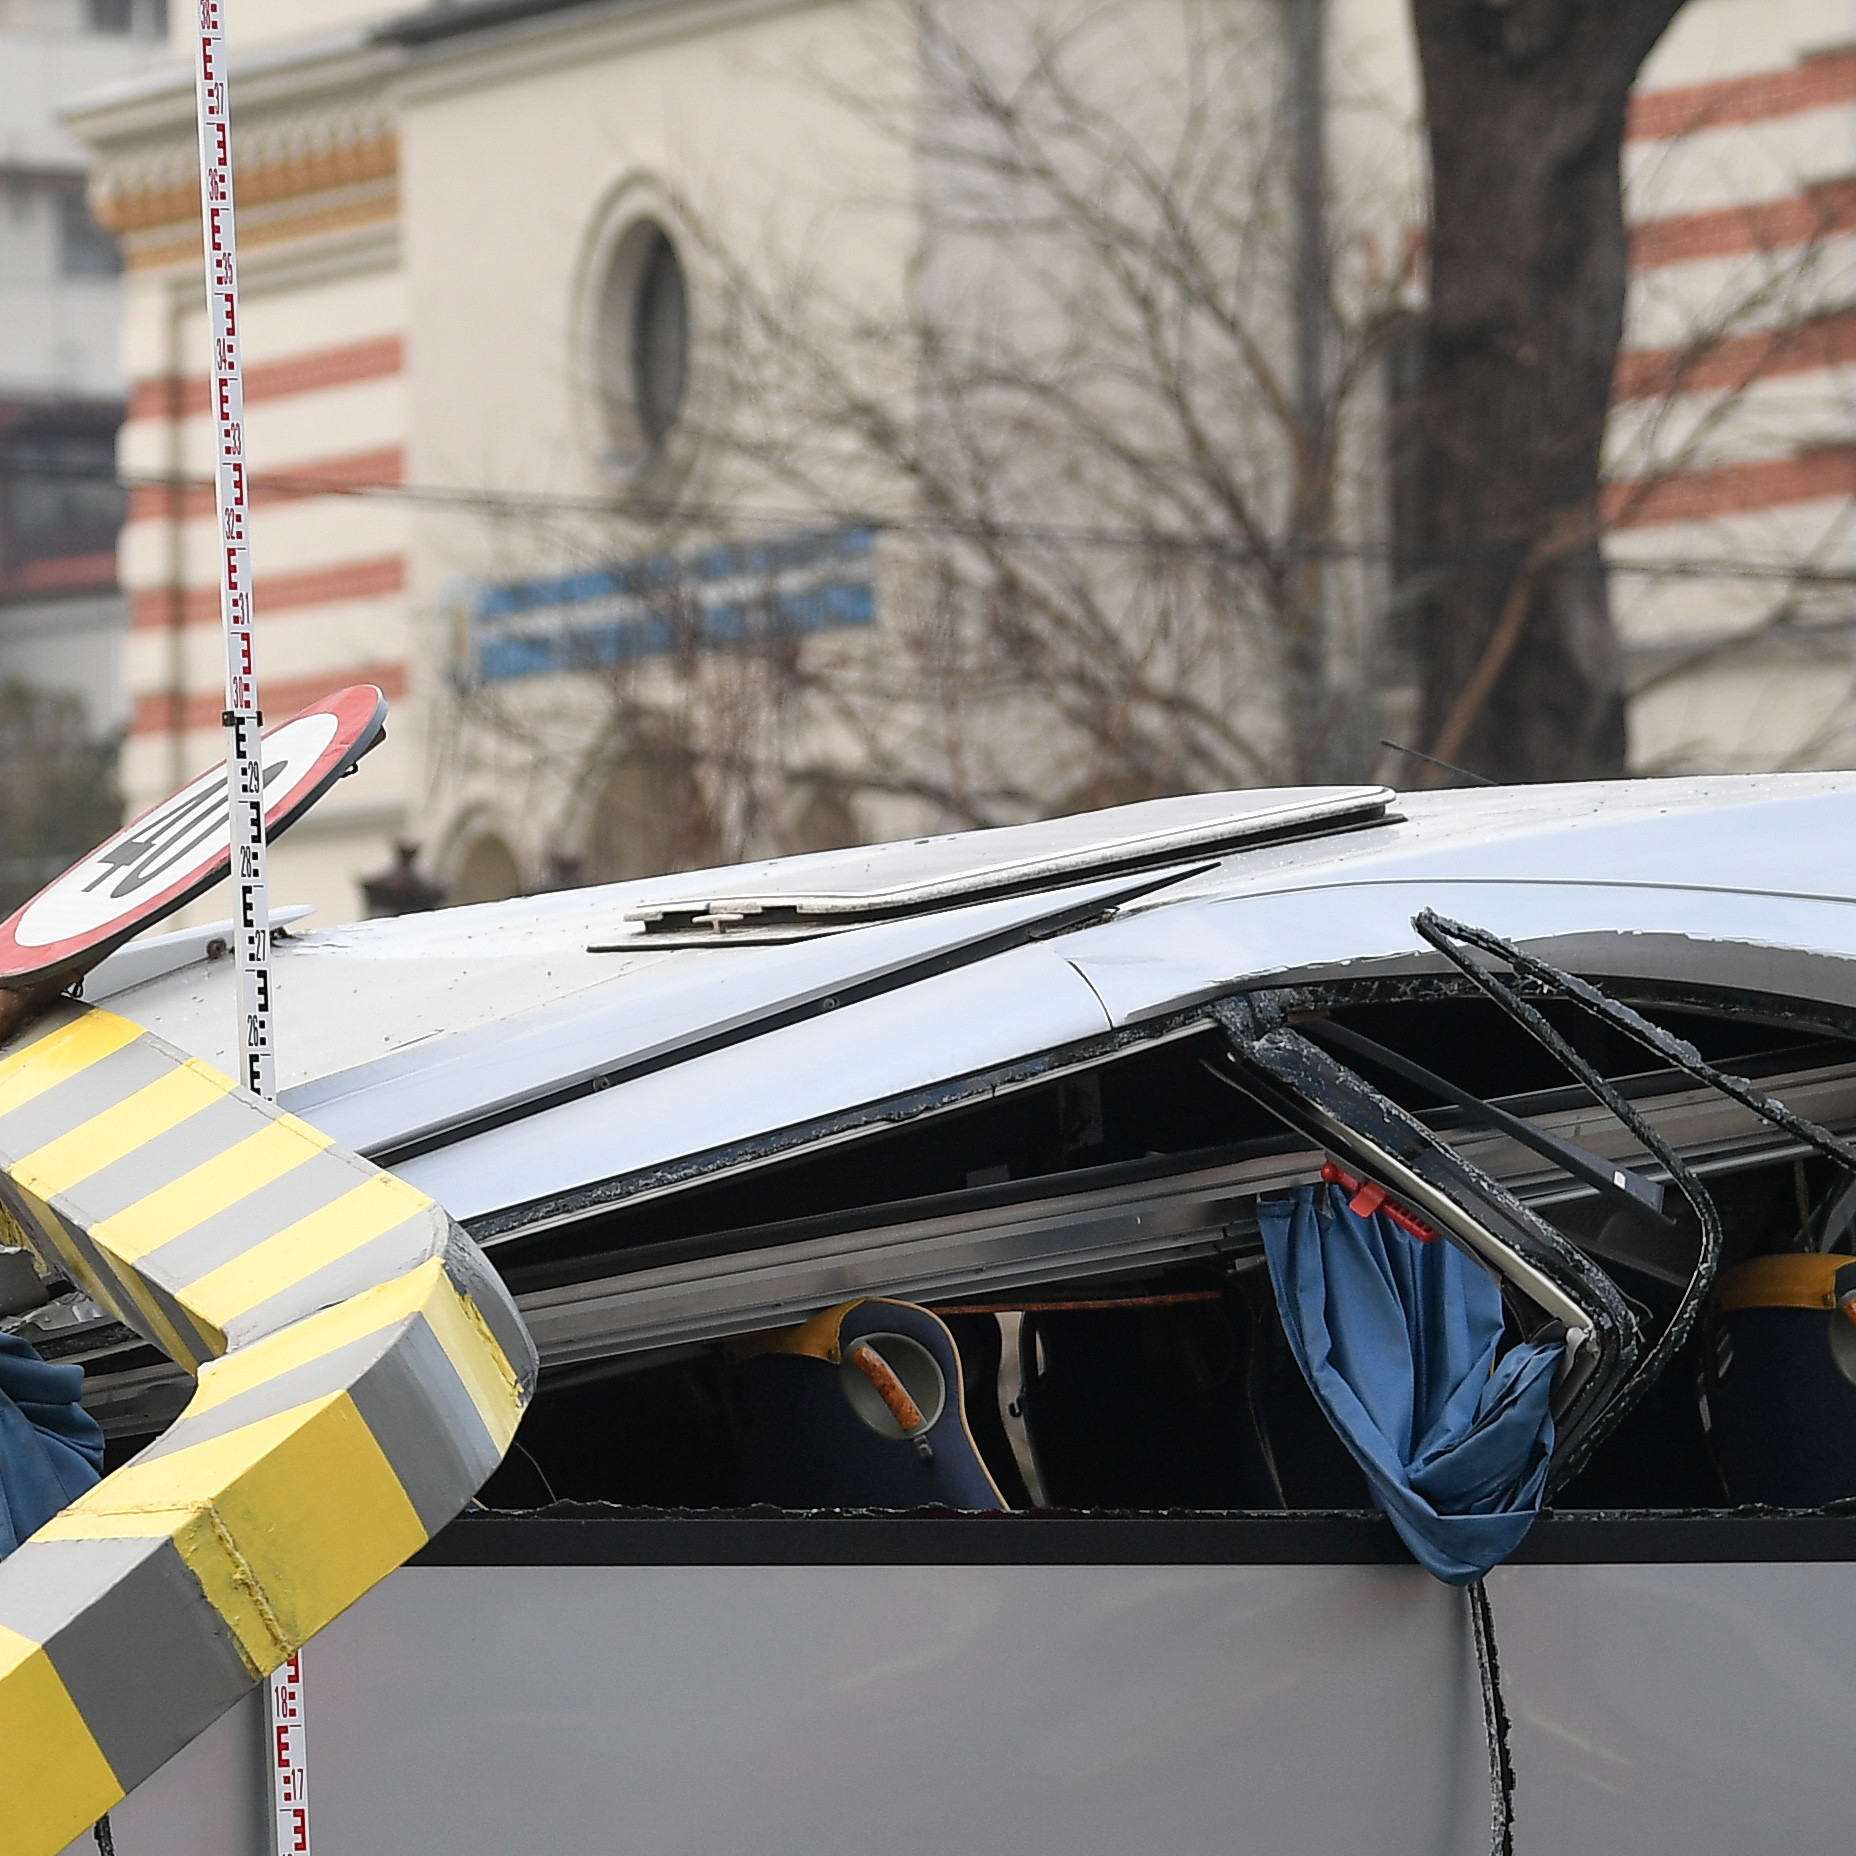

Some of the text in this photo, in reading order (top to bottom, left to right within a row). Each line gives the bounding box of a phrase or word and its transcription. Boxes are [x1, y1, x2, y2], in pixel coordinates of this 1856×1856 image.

[225, 507, 235, 540] 32
[238, 592, 250, 625] 31
[233, 676, 244, 709] 30
[248, 761, 260, 793] 29
[81, 759, 289, 899] 40
[240, 845, 251, 878] 28
[255, 929, 266, 962] 27
[247, 1014, 259, 1047] 26
[274, 1685, 288, 1718] 18
[291, 1768, 303, 1800] 17
